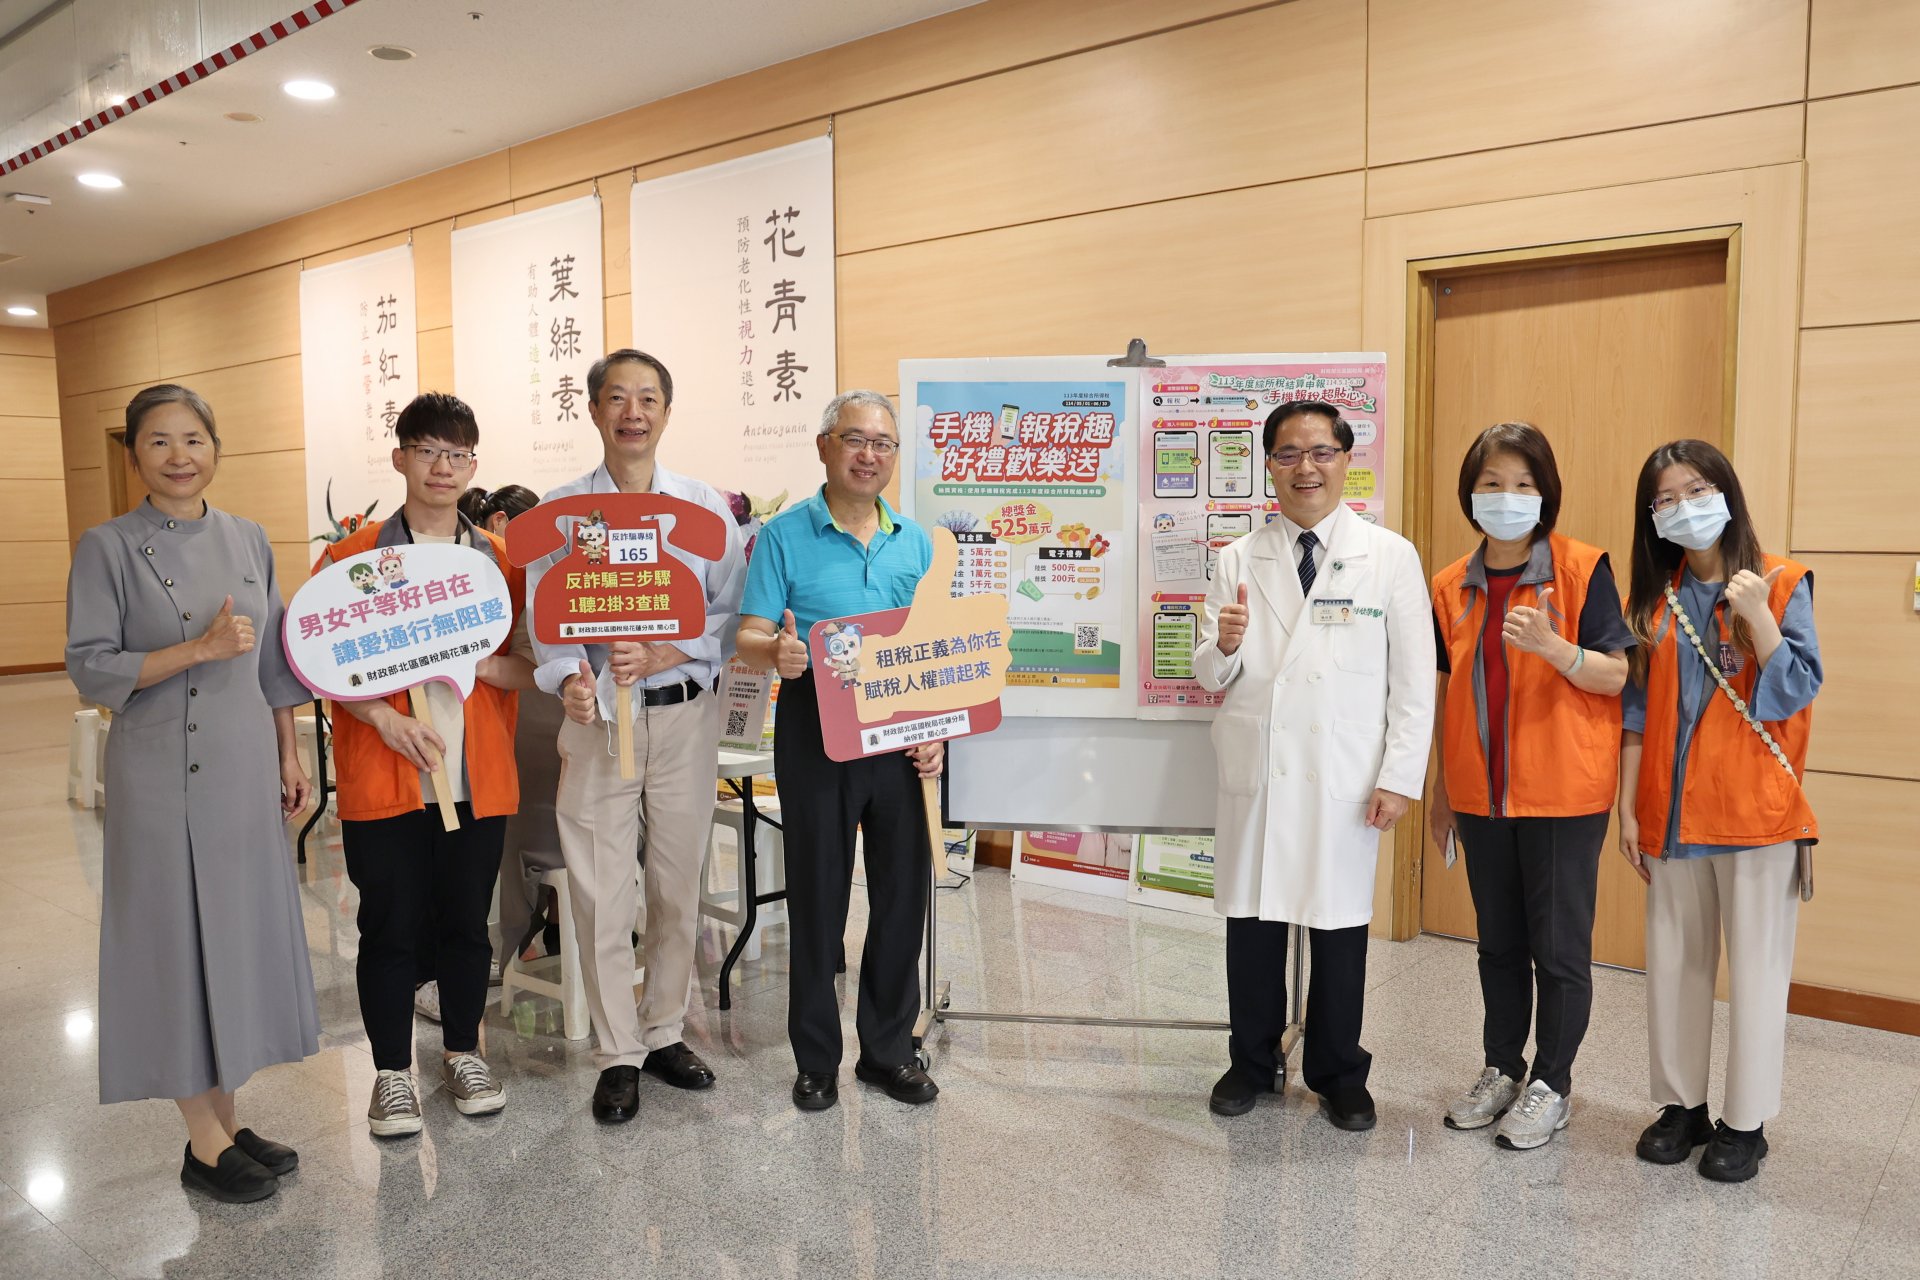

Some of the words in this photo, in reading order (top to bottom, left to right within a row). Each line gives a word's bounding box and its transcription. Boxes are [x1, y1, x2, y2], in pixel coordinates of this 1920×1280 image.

[736, 217, 755, 407] 預防老化性視力退化
[764, 206, 809, 403] 花青素
[528, 263, 542, 426] 有助人體造血功能
[549, 254, 583, 422] 葉綠素
[377, 294, 401, 439] 茄紅素
[1270, 388, 1358, 402] 手機報稅超貼心
[1156, 417, 1163, 428] 2
[1211, 416, 1218, 427] 3
[943, 445, 1098, 478] 好禮歡樂送
[1001, 503, 1037, 517] 總獎金
[991, 517, 1052, 538] 525萬元
[612, 532, 654, 541] 反詐騙專線
[958, 534, 984, 542] 現金獎
[619, 547, 648, 562] 165
[970, 548, 992, 556] 5萬元
[1048, 549, 1083, 558] 電子禮券
[970, 559, 992, 567] 2萬元
[1051, 564, 1076, 572] 500元
[566, 570, 671, 590] 反詐騙三步驟
[971, 569, 992, 578] 1萬元
[1051, 574, 1076, 583] 200元
[970, 580, 992, 589] 5千元
[299, 573, 474, 640] 男女平等好自在
[569, 594, 670, 614] 1聽2掛3查證
[332, 597, 507, 666] 讓愛通行無阻愛
[578, 623, 655, 634] 財政部北區國稅局花蓮分局
[657, 622, 676, 631] 關心您
[875, 630, 1002, 669] 租稅正義為你在
[367, 639, 491, 682] 財政部北區國稅局花蓮分局
[865, 660, 991, 701] 賦稅人權讚起來
[883, 714, 965, 737] 財政部北區國稅局花蓮分局
[904, 732, 925, 743] 納保官
[927, 728, 948, 738] 關心您
